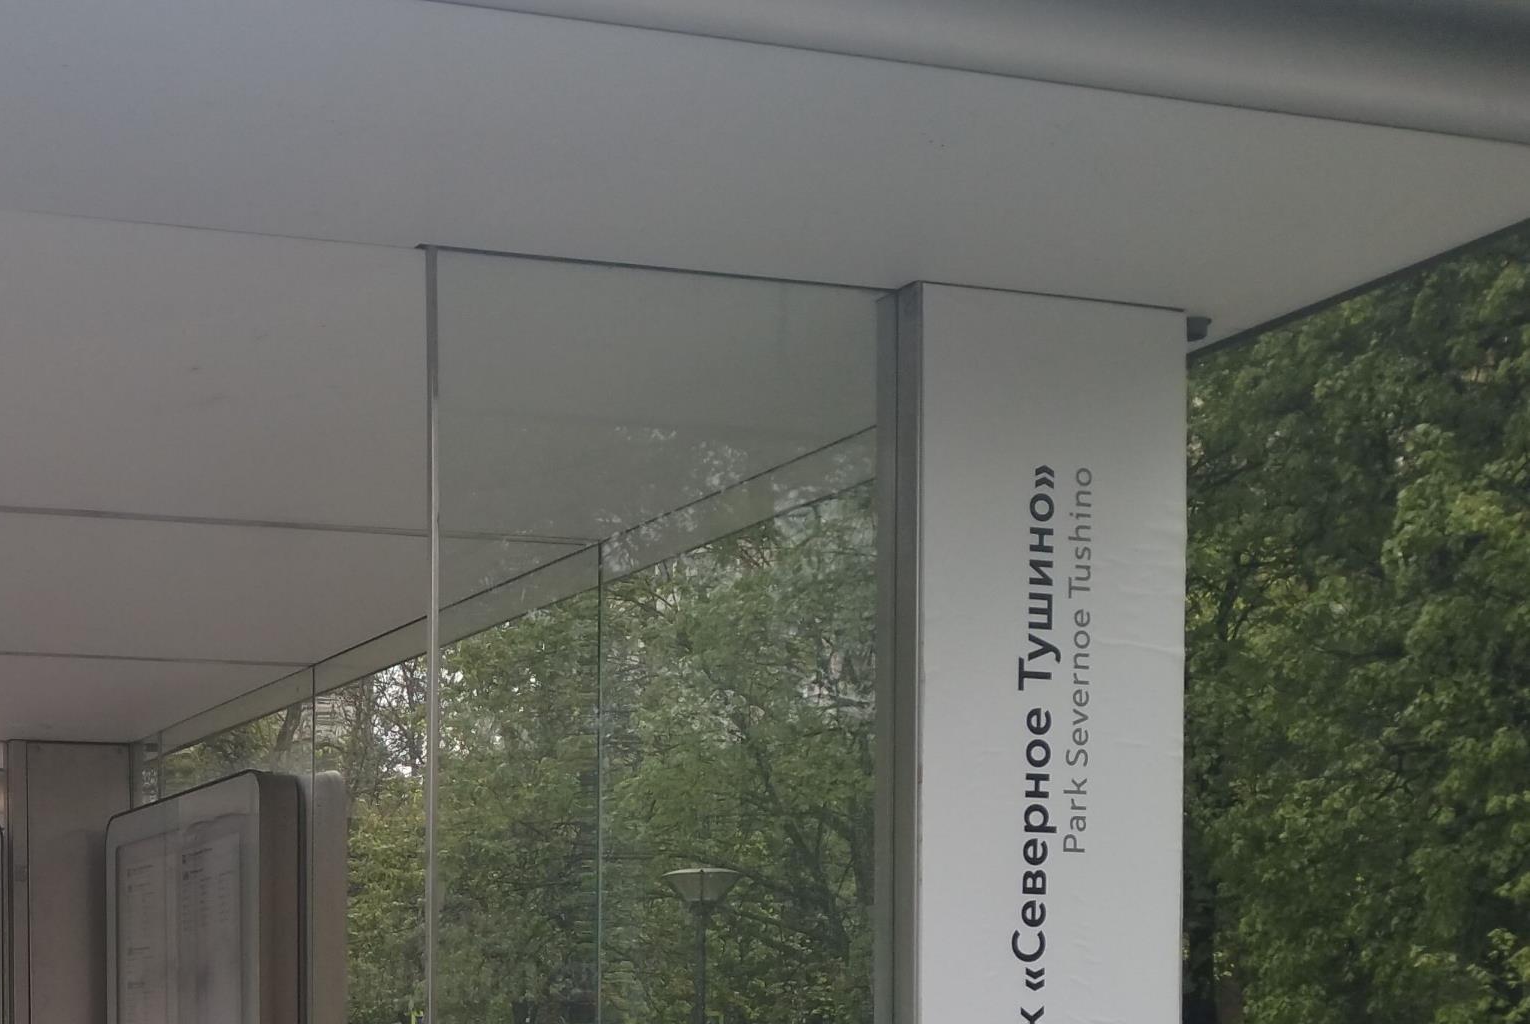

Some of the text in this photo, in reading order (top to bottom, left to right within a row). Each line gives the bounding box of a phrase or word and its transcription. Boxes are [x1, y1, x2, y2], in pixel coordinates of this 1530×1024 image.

[1018, 463, 1061, 691] Тушино»
[1063, 467, 1093, 854] Park Severnoe Tushino
[1011, 707, 1057, 992] «Северное
